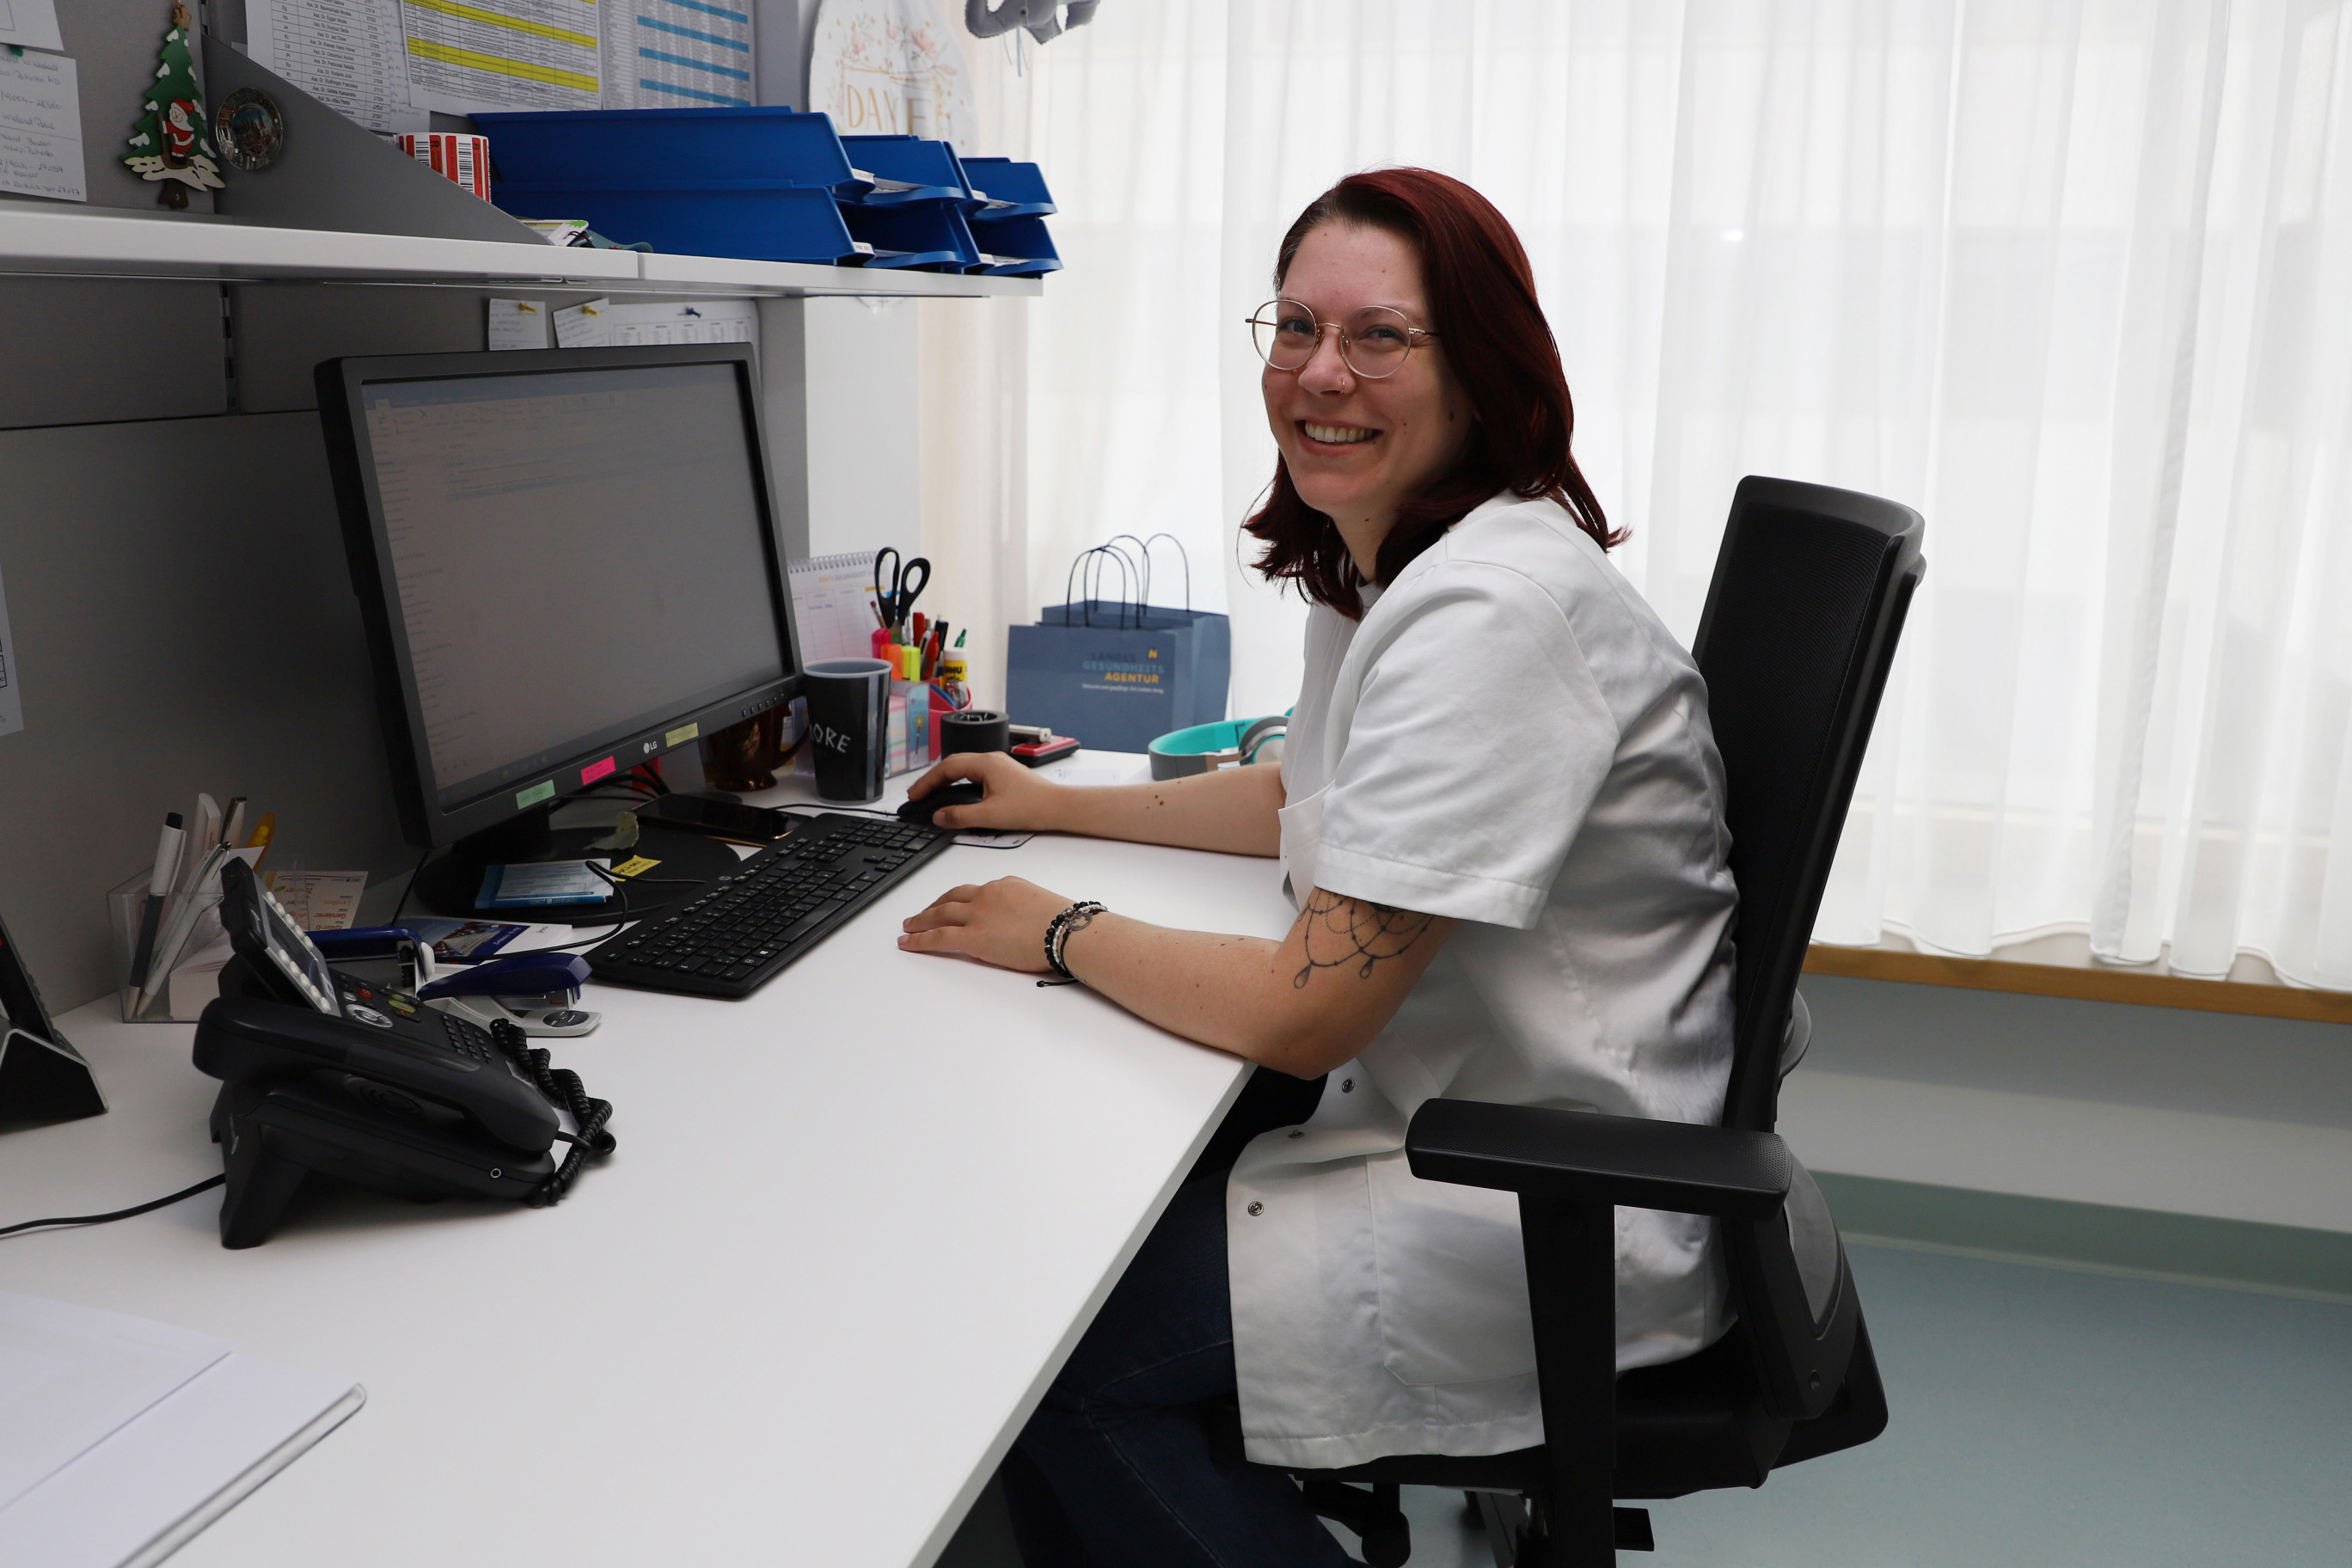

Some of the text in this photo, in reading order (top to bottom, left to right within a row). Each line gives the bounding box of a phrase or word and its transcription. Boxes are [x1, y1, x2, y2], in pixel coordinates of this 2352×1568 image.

[1082, 660, 1165, 674] GESUNDHEITS
[1104, 671, 1160, 684] AGENTUR
[810, 723, 851, 754] ORE
[649, 741, 658, 750] LG
